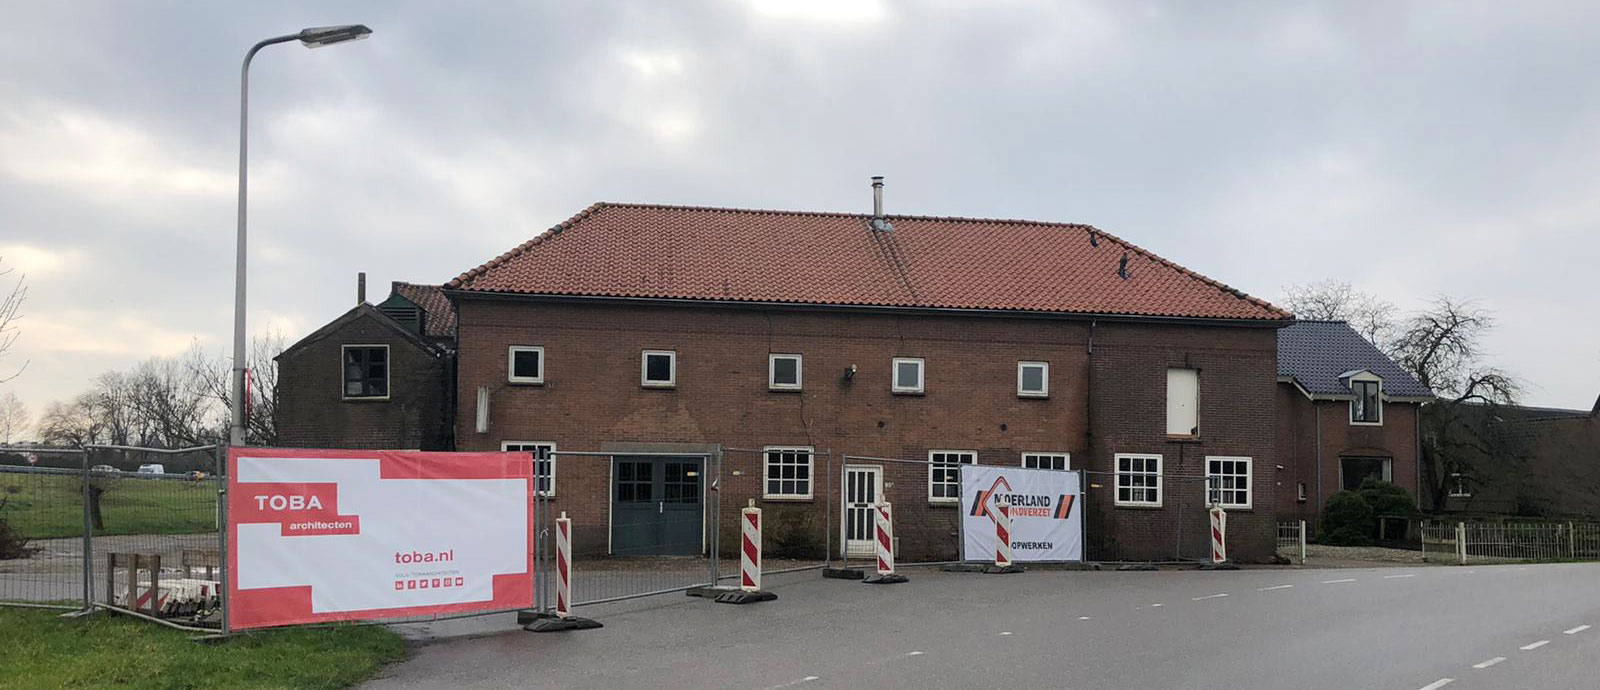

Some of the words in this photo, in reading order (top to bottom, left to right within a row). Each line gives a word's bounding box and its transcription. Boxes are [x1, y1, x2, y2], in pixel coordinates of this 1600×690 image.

[254, 494, 323, 511] TOBA
[1010, 507, 1051, 517] NDVERZET
[289, 520, 353, 531] architecten
[394, 549, 454, 564] toba.nl
